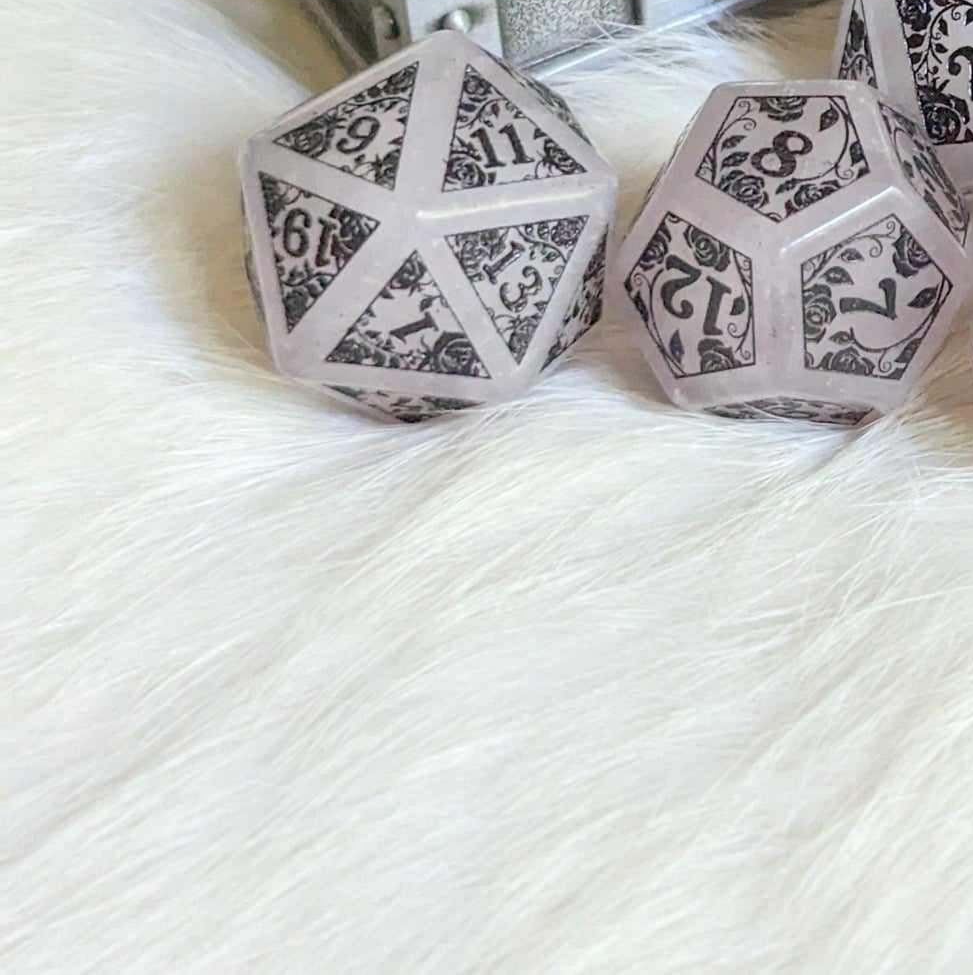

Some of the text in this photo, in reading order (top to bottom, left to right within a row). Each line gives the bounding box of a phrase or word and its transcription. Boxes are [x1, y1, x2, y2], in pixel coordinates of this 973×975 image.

[470, 124, 535, 168] 11
[751, 130, 813, 177] 8
[283, 208, 334, 267] 19
[482, 240, 543, 312] 13
[661, 255, 731, 336] 12
[839, 278, 897, 320] 7
[390, 312, 439, 341] 1
